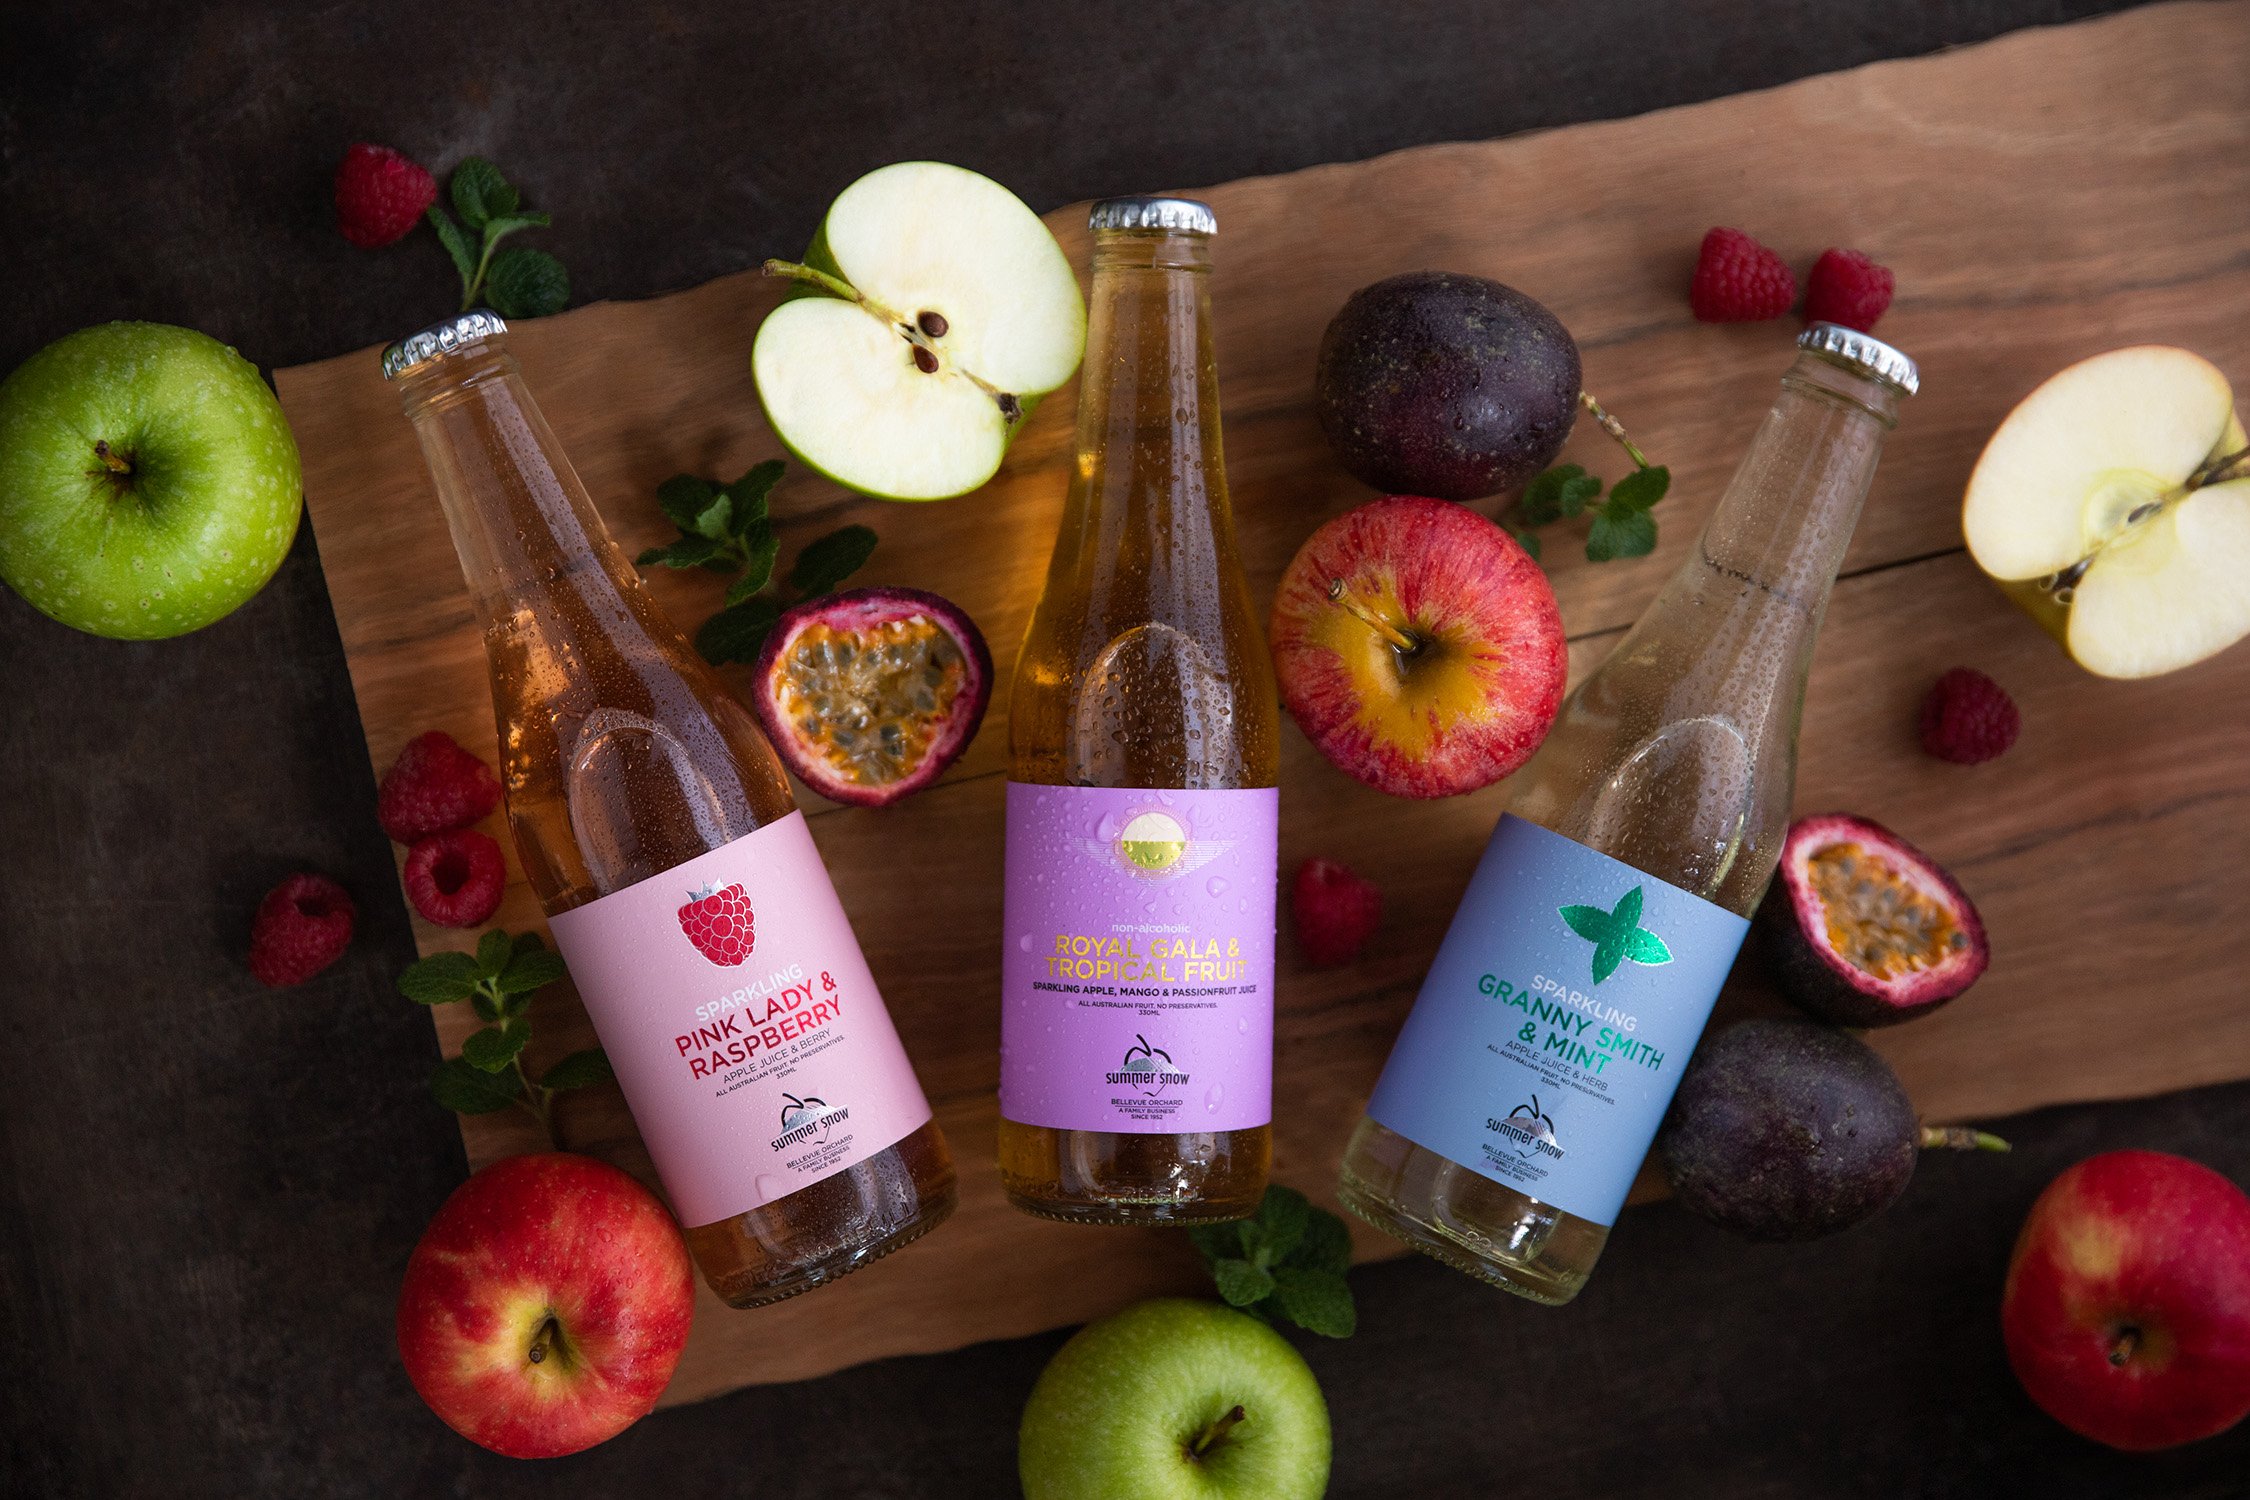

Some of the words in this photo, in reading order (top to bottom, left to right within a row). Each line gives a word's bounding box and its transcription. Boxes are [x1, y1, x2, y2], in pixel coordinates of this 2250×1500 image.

[1111, 923, 1191, 933] non-alcoholic
[1055, 934, 1141, 958] ROYAL
[1150, 937, 1221, 959] GALA
[1227, 937, 1240, 958] &
[1044, 956, 1175, 982] TROPICAL
[1184, 960, 1247, 982] FRUIT
[696, 964, 803, 1021] SPARKLING
[1033, 981, 1080, 993] SPARKLING
[1082, 985, 1117, 997] APPLE,
[1120, 987, 1160, 997] MANGO
[1162, 988, 1169, 996] &
[1172, 987, 1237, 997] PASSIONFRUIT
[1238, 985, 1257, 994] JUICE
[1531, 974, 1638, 1031] SPARKLING
[675, 1014, 742, 1057] PINK
[746, 979, 813, 1027] LADY
[821, 971, 837, 992] &
[1092, 1001, 1133, 1009] AUSTRALIAN
[1478, 974, 1593, 1036] GRANNY
[1595, 1027, 1665, 1071] SMITH
[689, 994, 841, 1080] RASPBERRY
[1518, 1021, 1536, 1044] &
[1544, 1032, 1612, 1075] MINT
[723, 1063, 757, 1084] APPLE
[760, 1049, 789, 1068] JUICE
[791, 1045, 798, 1054] &
[800, 1028, 831, 1050] BERRY
[1487, 1044, 1499, 1053] ALL
[1499, 1050, 1540, 1072] AUSTRALIAN
[1505, 1040, 1540, 1061] APPLE
[1541, 1056, 1572, 1075] JUICE
[1572, 1070, 1580, 1079] &
[1582, 1073, 1608, 1091] HERB
[716, 1087, 728, 1097] ALL
[729, 1070, 768, 1092] AUSTRALIAN
[789, 1057, 800, 1065] NO
[776, 1067, 797, 1080] 330ML
[1106, 1072, 1156, 1084] summer
[1160, 1073, 1190, 1085] snow
[1540, 1077, 1560, 1090] 330ML
[1111, 1098, 1147, 1106] BELLEVUE
[771, 1121, 818, 1152] summer
[820, 1108, 849, 1128] snow
[1486, 1118, 1535, 1146] summer
[1535, 1140, 1565, 1160] snow
[786, 1150, 820, 1168] BELLEVUE
[821, 1134, 854, 1153] ORCHARD
[803, 1158, 823, 1170] FAMILY
[823, 1146, 850, 1160] BUSINESS
[811, 1162, 828, 1173] SINCE
[829, 1156, 841, 1165] 1952
[1482, 1143, 1516, 1163] BELLEVUE
[1517, 1160, 1548, 1177] ORCHARD
[1492, 1158, 1512, 1169] FAMILY
[1513, 1166, 1538, 1181] BUSINESS
[1495, 1165, 1512, 1176] SINCE
